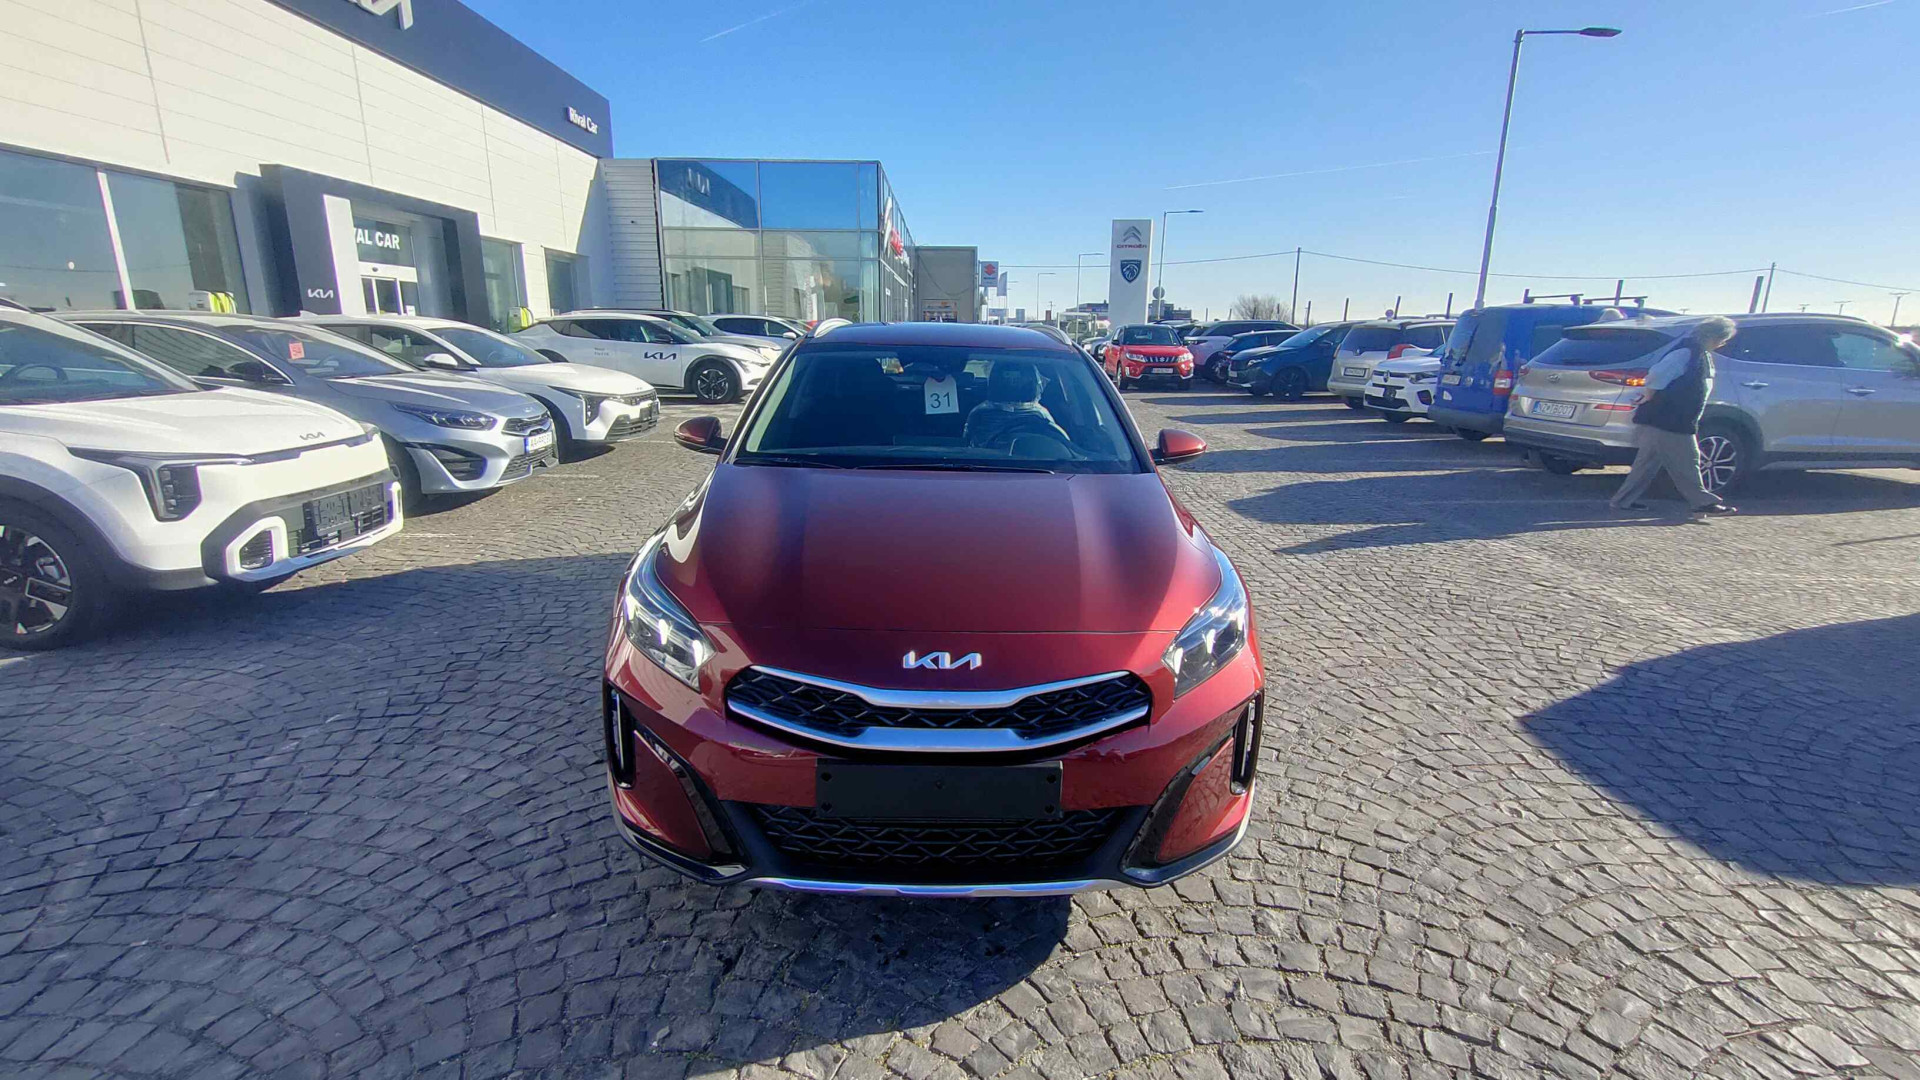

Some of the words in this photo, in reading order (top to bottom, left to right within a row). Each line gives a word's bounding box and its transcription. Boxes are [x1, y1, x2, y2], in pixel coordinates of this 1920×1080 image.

[568, 106, 587, 129] Rival
[587, 117, 598, 134] Car
[375, 231, 400, 250] CAR
[307, 288, 334, 299] KIA
[644, 351, 677, 361] KIA
[930, 391, 951, 409] 31
[903, 650, 982, 670] KIA
